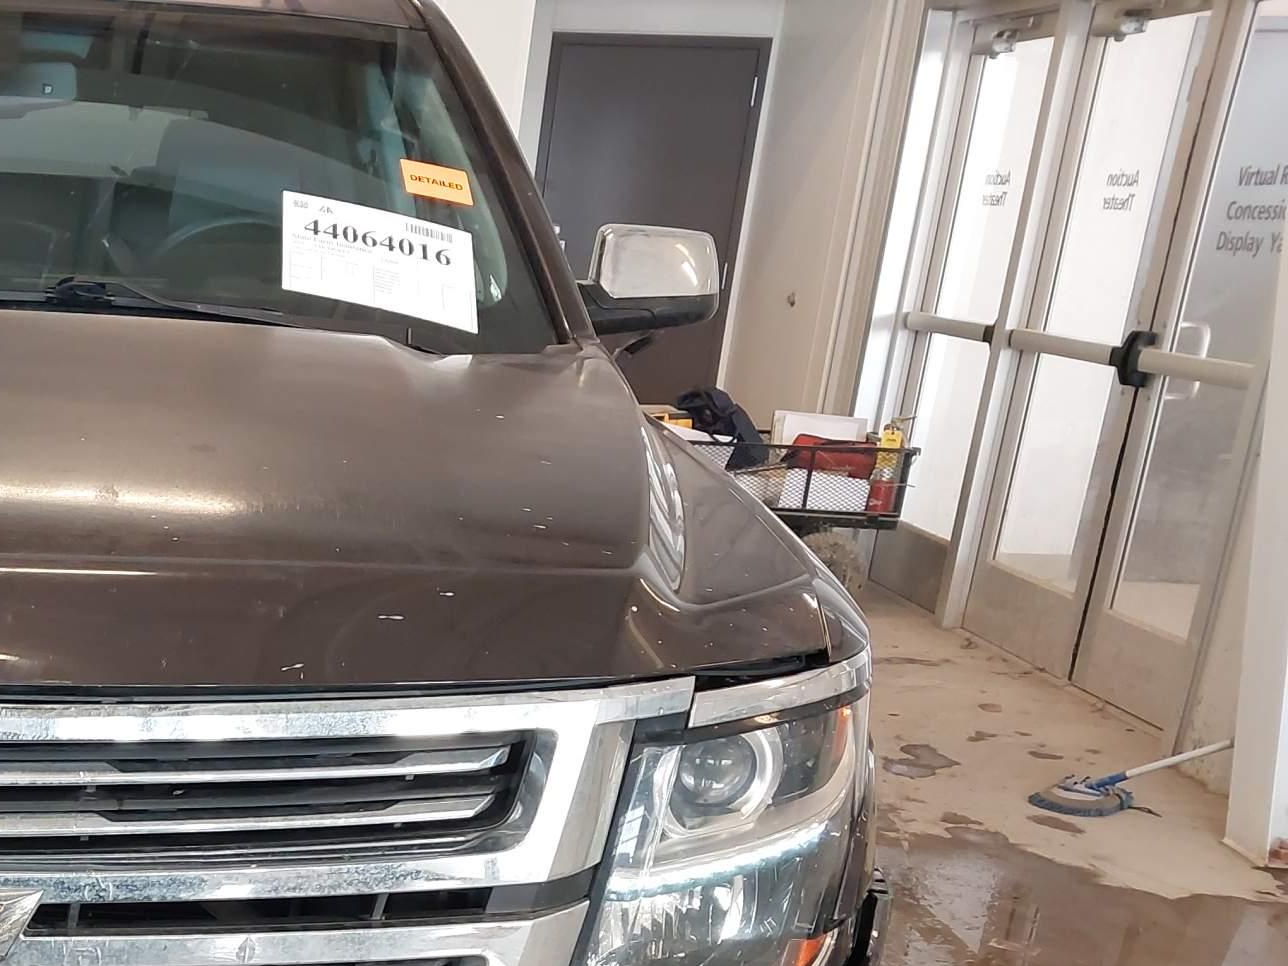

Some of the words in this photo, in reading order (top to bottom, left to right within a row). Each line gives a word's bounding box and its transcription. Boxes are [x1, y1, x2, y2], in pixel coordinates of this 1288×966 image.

[409, 174, 464, 191] DETAILED
[1238, 165, 1280, 187] Virtual
[303, 218, 452, 266] 44064016
[1215, 230, 1265, 258] Display
